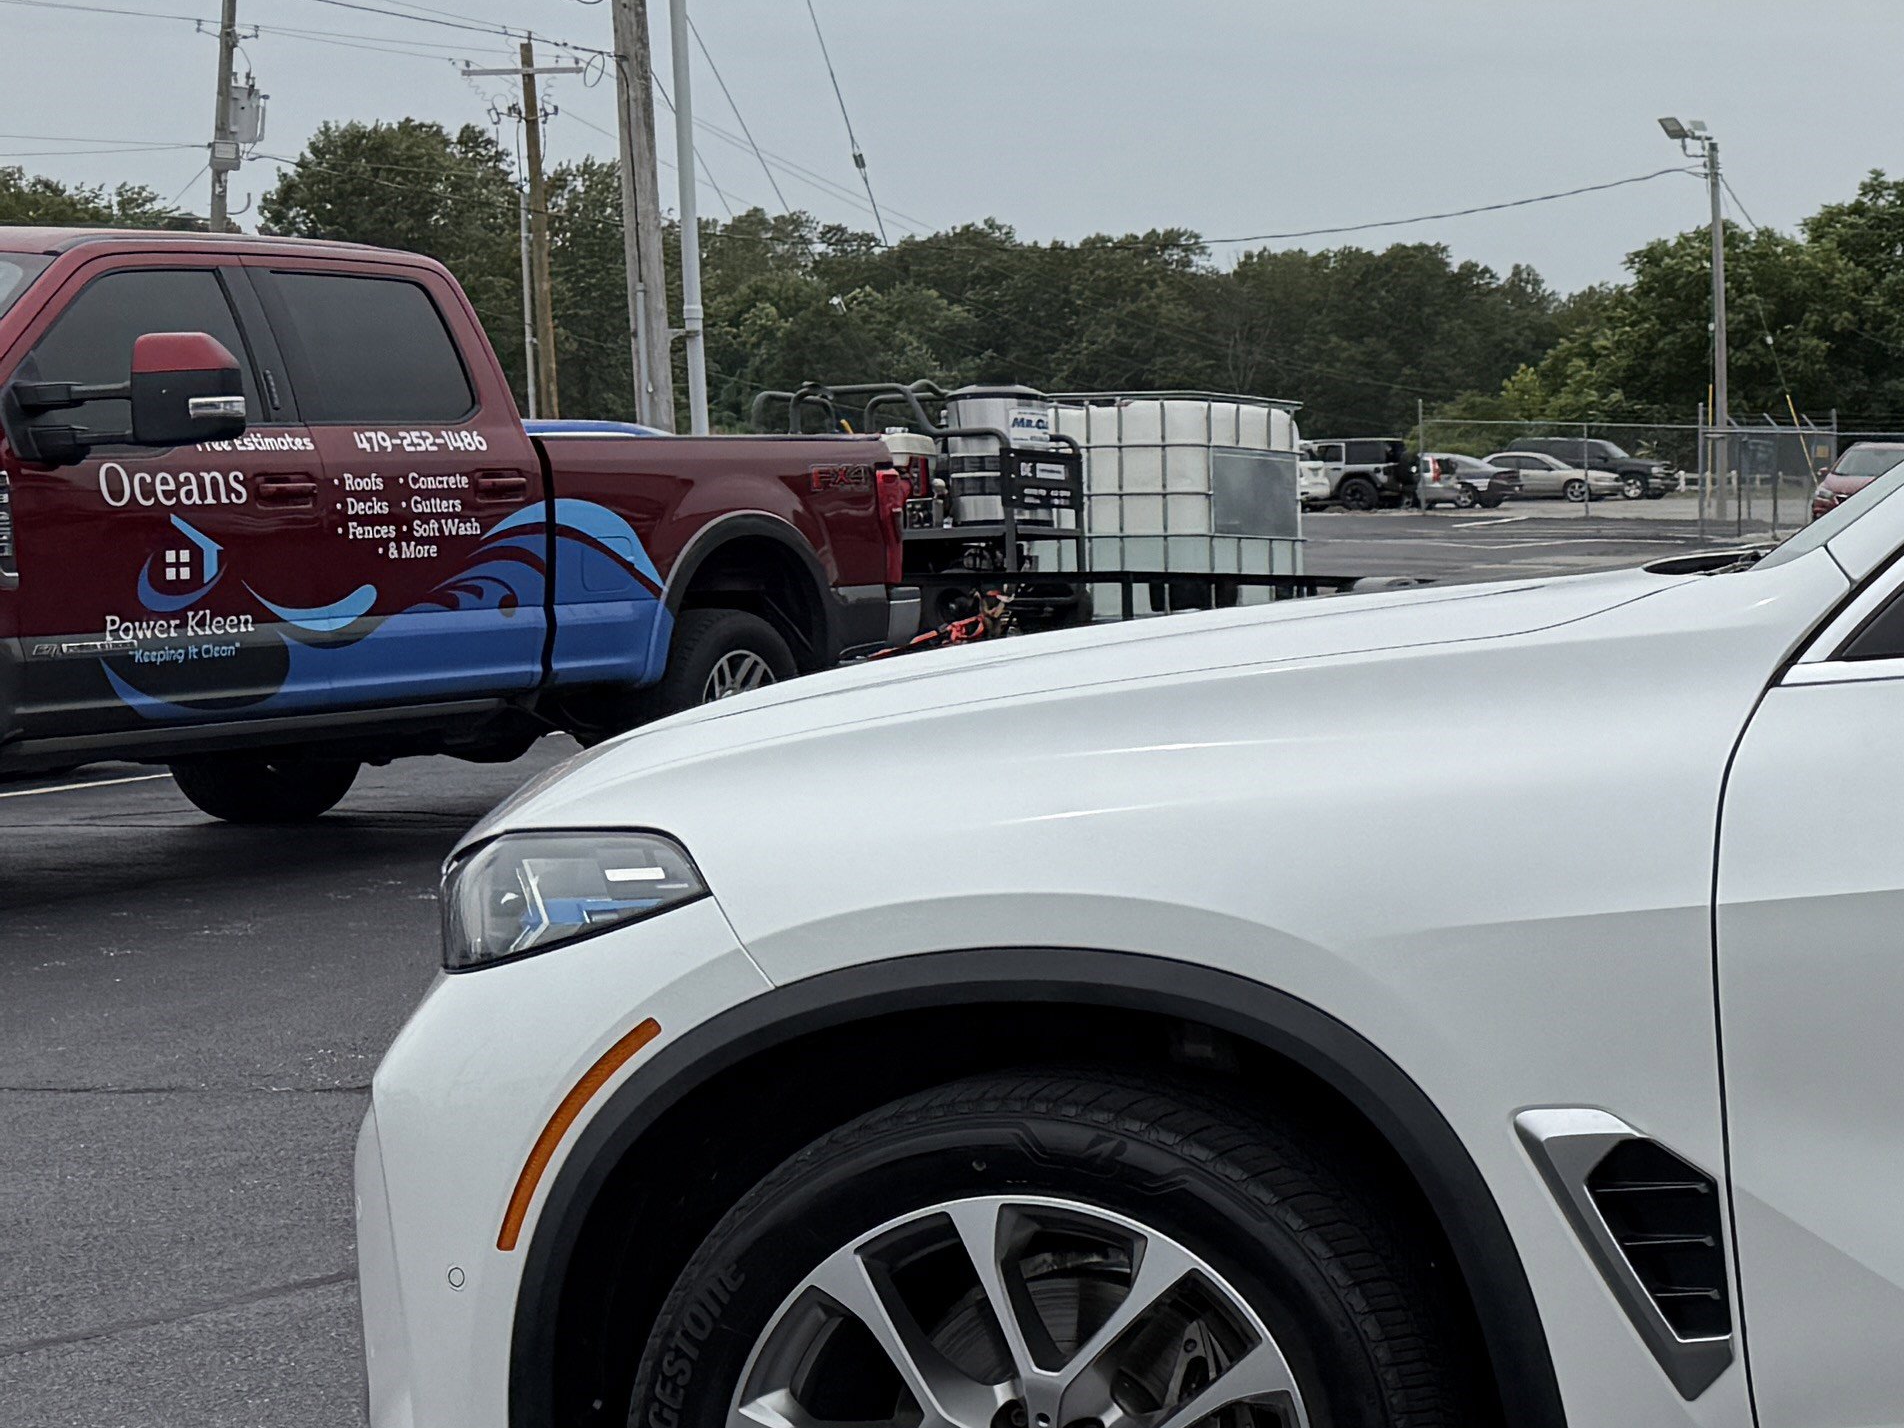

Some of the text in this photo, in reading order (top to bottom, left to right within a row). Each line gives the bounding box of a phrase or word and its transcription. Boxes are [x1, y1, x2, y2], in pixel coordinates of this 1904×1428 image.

[233, 432, 315, 452] Estimates
[352, 430, 488, 453] 479-252-1486
[99, 462, 248, 507] Oceans
[343, 472, 384, 491] Roofs
[407, 471, 470, 490] Concrete
[346, 497, 389, 515] Decks
[410, 495, 462, 513] Gutters
[348, 521, 396, 539] Fences
[413, 518, 481, 537] Soft Wash
[388, 541, 438, 560] & More
[105, 609, 255, 642] Power Kleen
